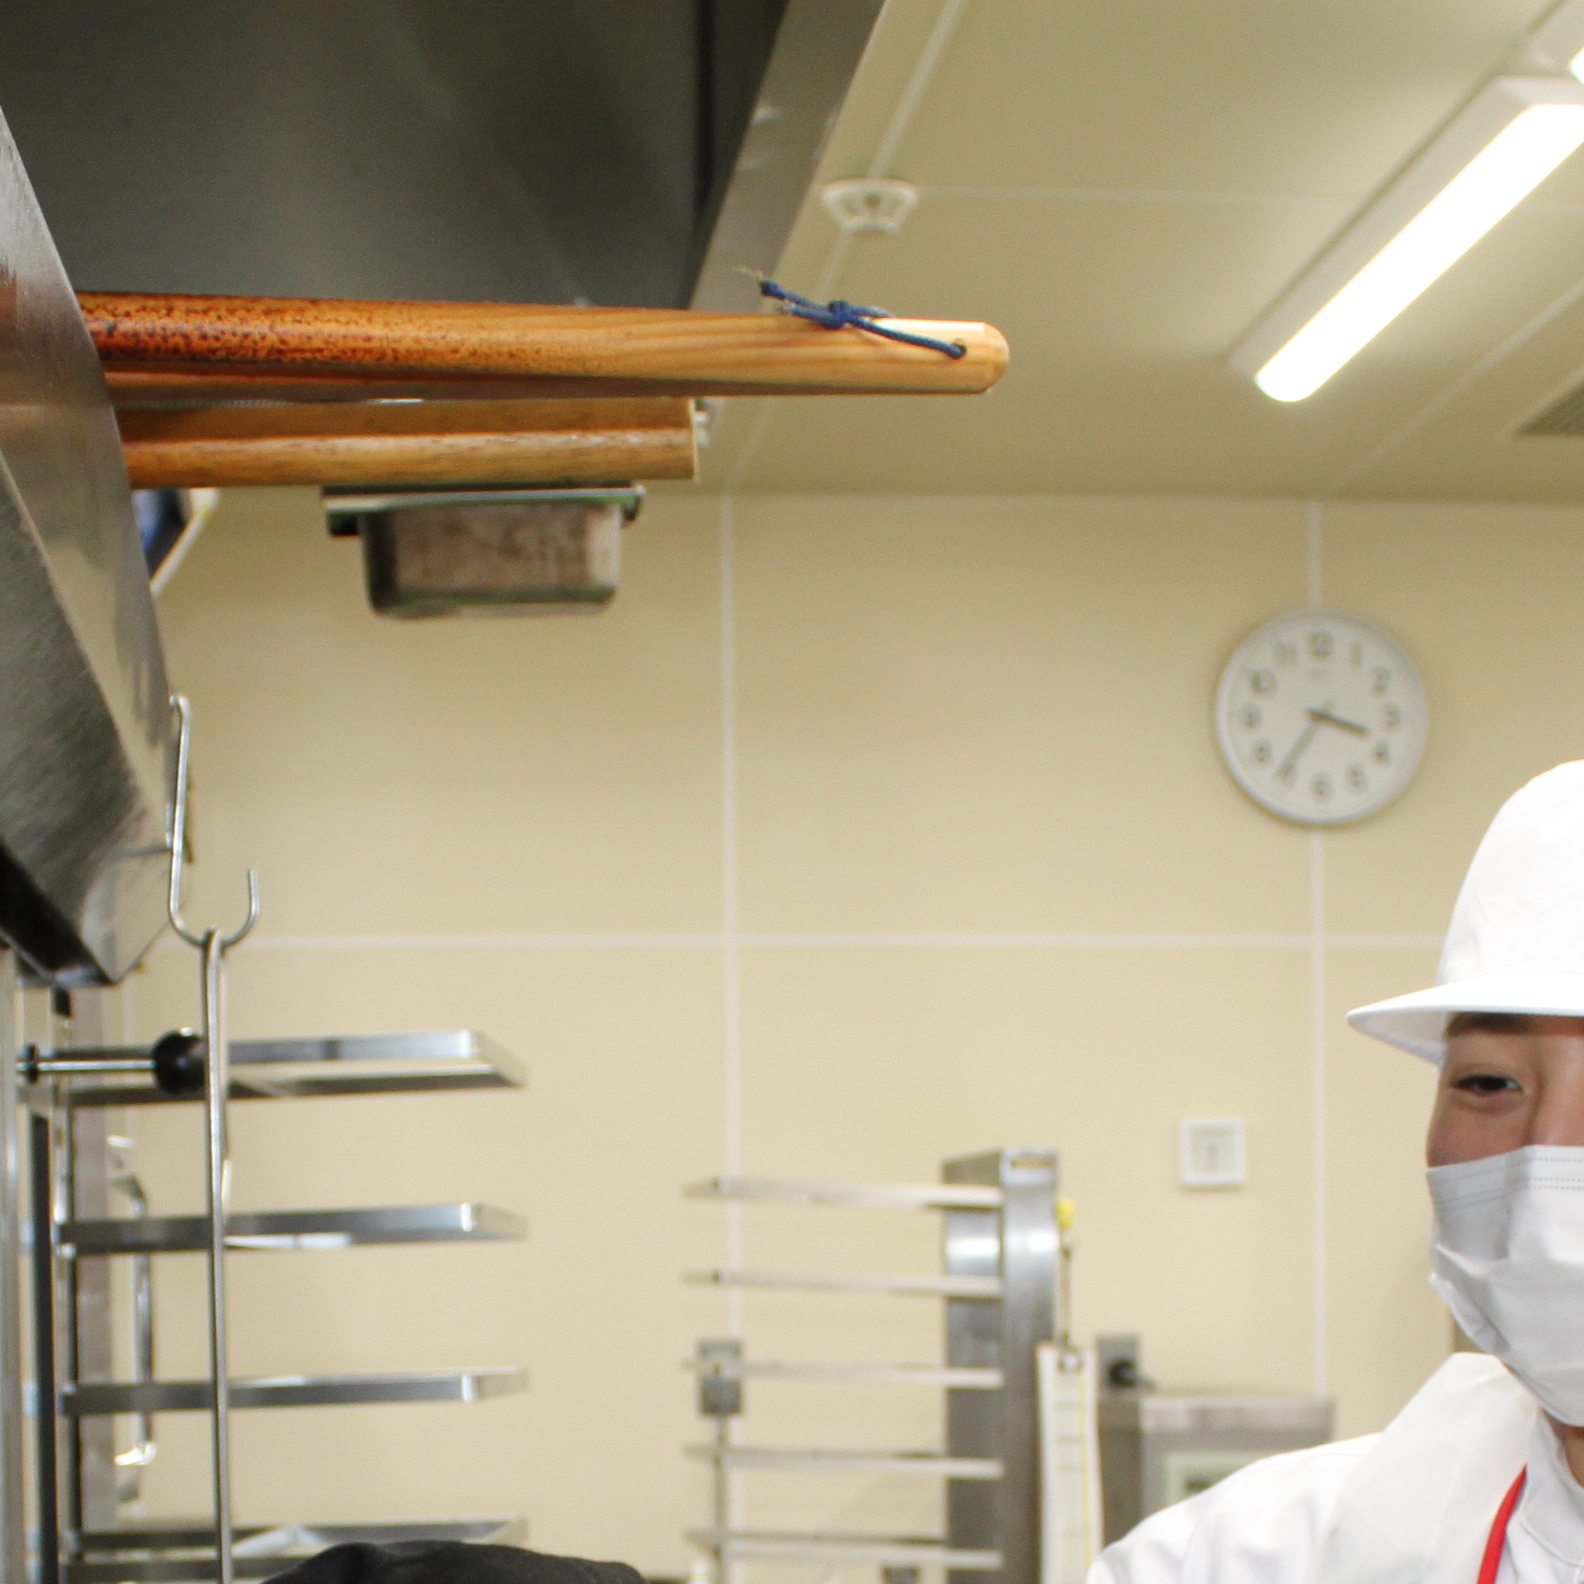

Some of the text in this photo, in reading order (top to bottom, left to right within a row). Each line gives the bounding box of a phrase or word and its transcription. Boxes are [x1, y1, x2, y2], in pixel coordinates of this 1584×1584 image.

[1309, 630, 1333, 659] 12
[1250, 668, 1276, 698] 10
[1371, 667, 1390, 696] 2
[1241, 703, 1260, 731] 9
[1382, 703, 1400, 731] 3
[1253, 739, 1271, 764] 8
[1372, 739, 1390, 765] 4
[1311, 773, 1331, 801] 6
[1347, 764, 1366, 793] 5
